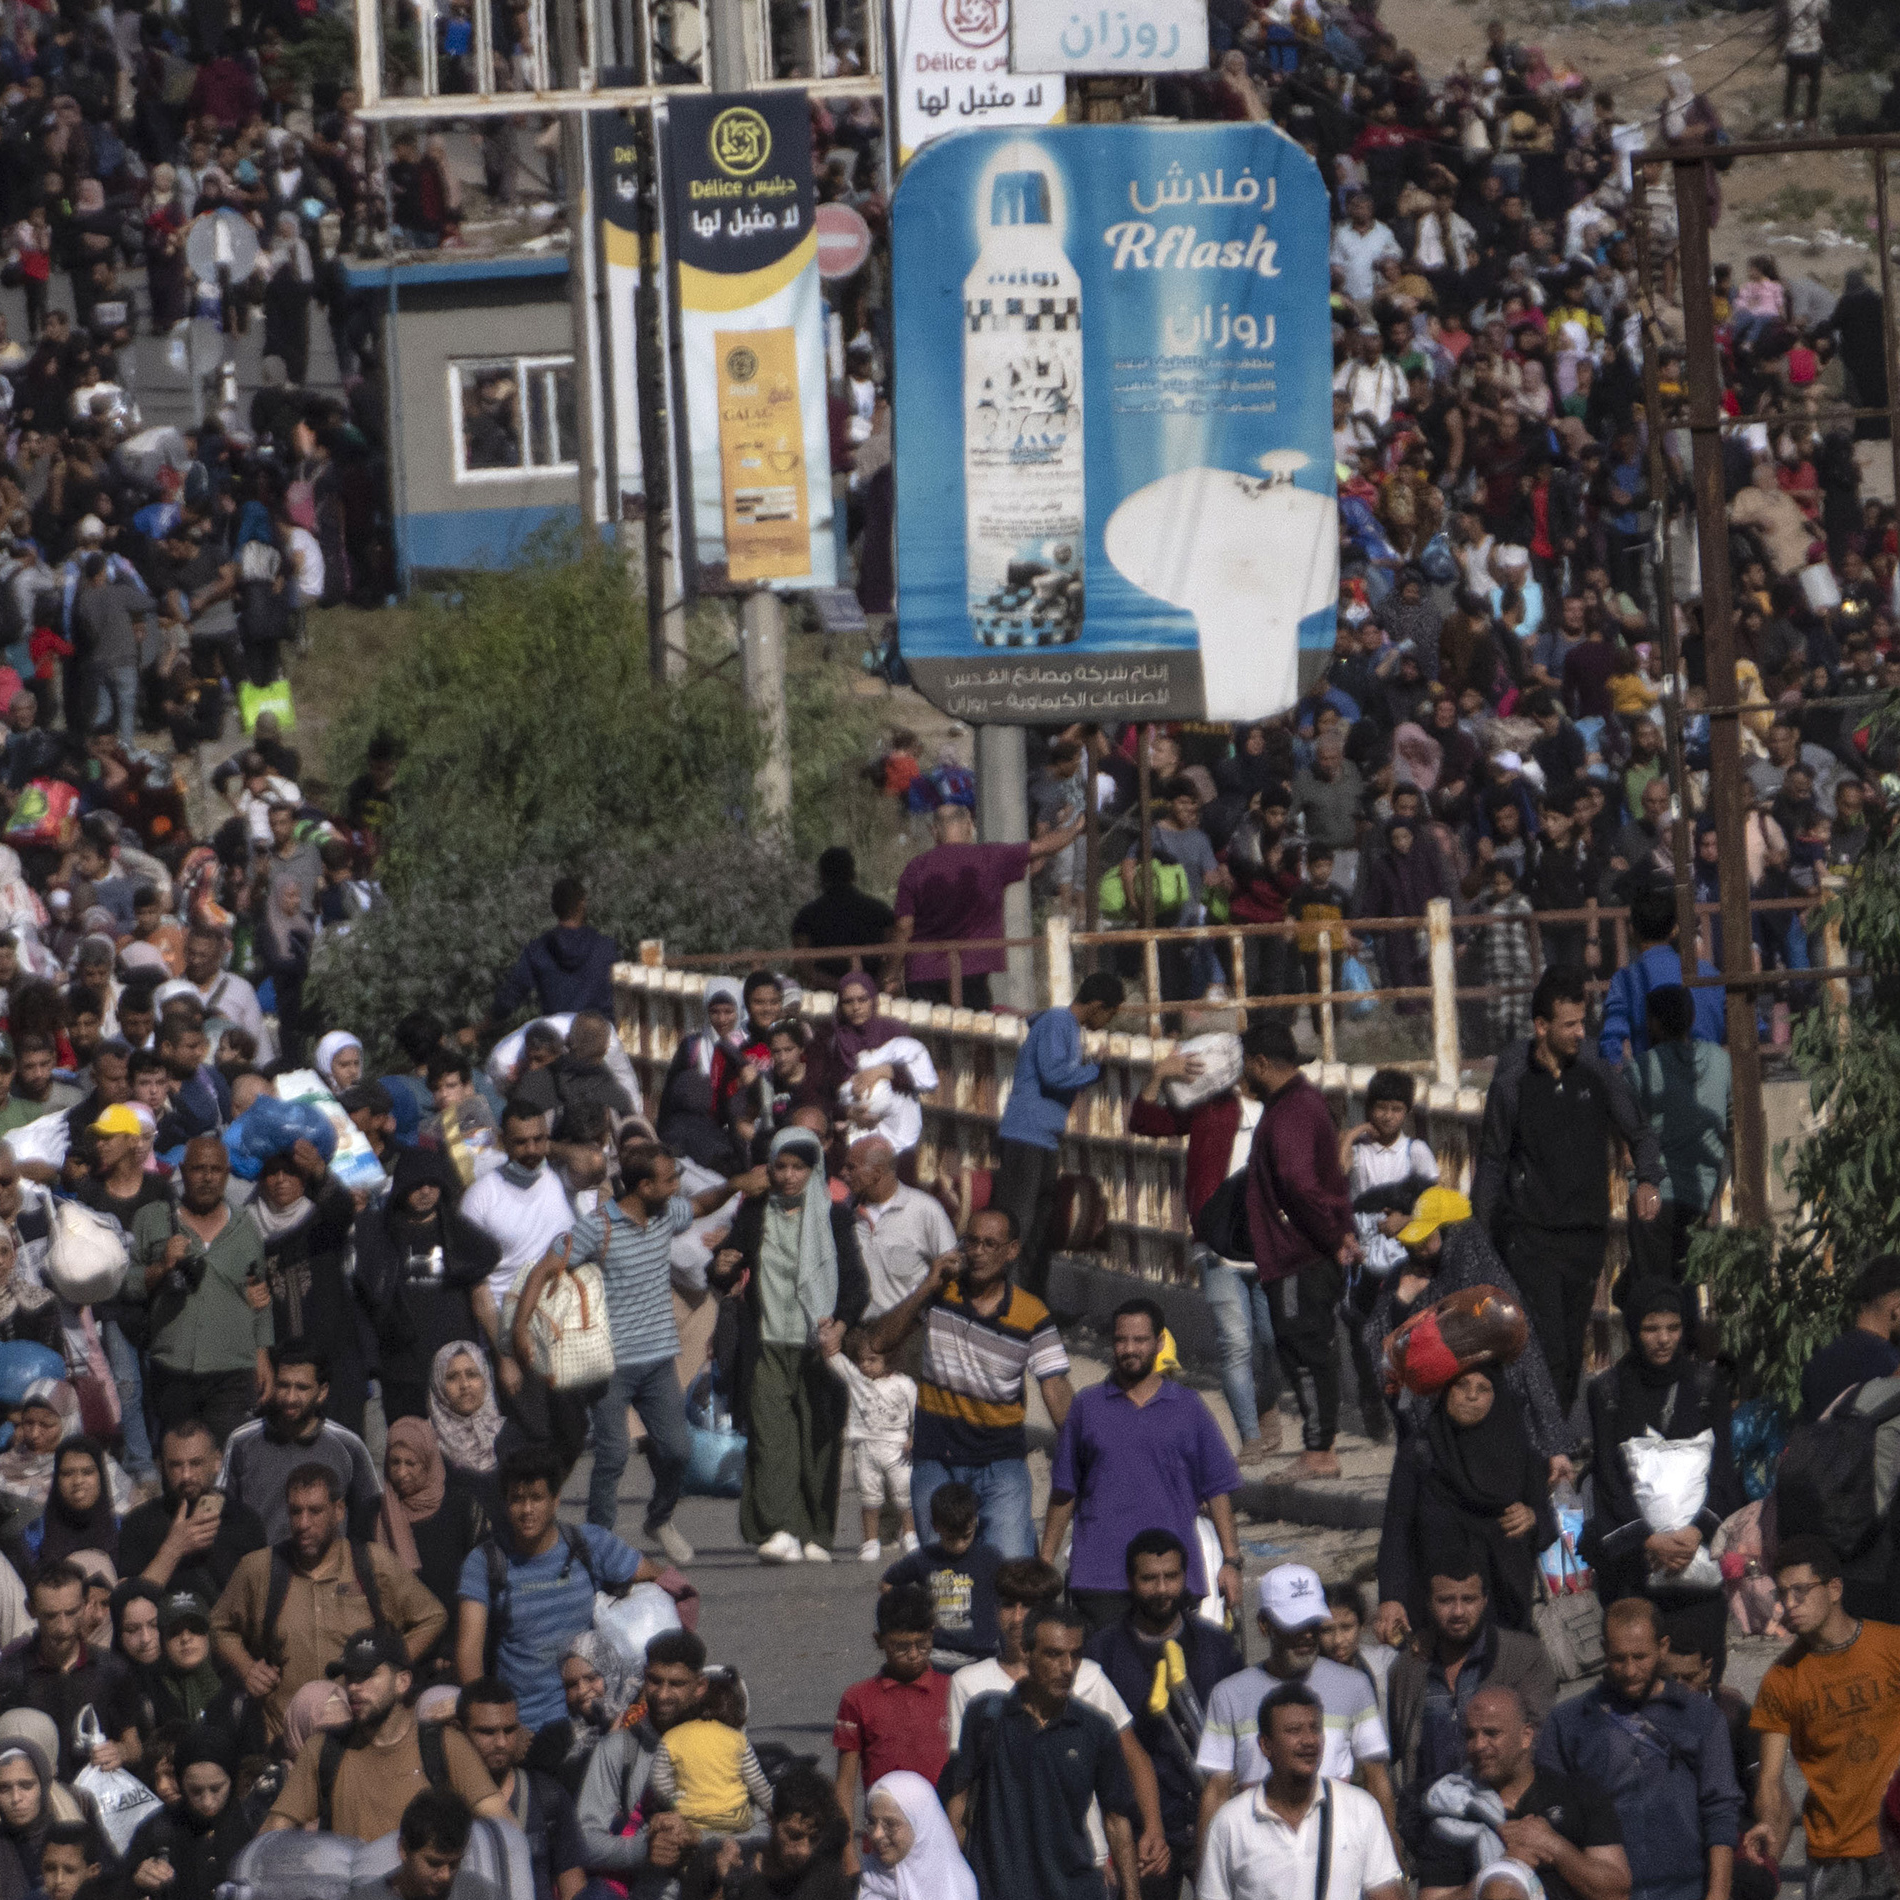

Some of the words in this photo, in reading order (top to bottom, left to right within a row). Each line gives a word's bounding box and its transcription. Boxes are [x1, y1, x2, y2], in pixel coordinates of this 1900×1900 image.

[1059, 8, 1180, 59] روزان
[915, 52, 977, 73] Délice
[916, 83, 950, 117] لها
[958, 82, 1016, 116] مثيل
[1021, 83, 1043, 107] لا
[689, 178, 743, 198] Délice
[1129, 160, 1277, 215] رفلاش
[692, 207, 722, 238] لها
[729, 202, 778, 237] مثيل
[782, 202, 800, 230] لا
[1103, 220, 1281, 278] Rflash
[947, 668, 1010, 689] القدس
[1012, 666, 1072, 687] مصانع
[1074, 663, 1129, 685] شركة
[948, 695, 988, 714] روزان
[1006, 690, 1087, 711] الكيماوية
